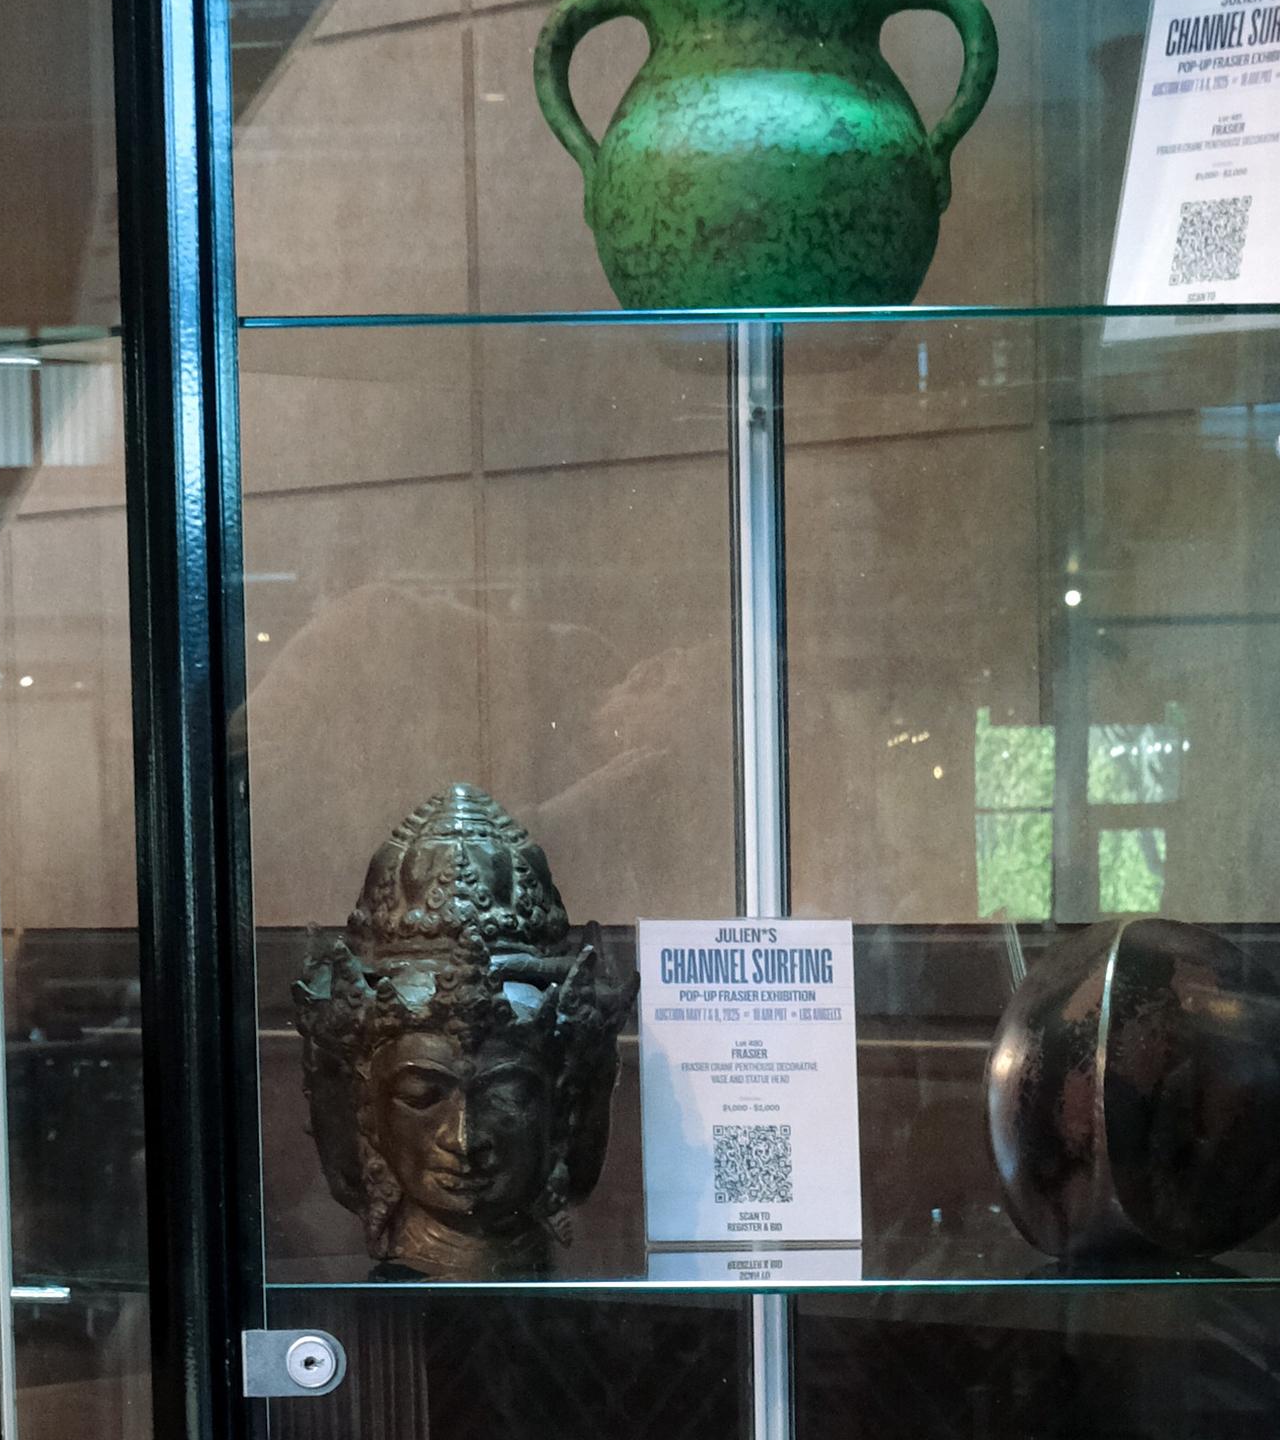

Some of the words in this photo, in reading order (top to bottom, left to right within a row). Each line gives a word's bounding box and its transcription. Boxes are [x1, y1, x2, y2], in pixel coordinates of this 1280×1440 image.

[1165, 10, 1247, 56] CHANNEL
[1178, 58, 1212, 74] POP-UP
[1212, 54, 1250, 70] FRASIER
[1211, 122, 1245, 136] FRASIER
[660, 948, 749, 984] CHANNEL
[751, 948, 833, 984] SURFING
[679, 990, 718, 1002] POP-UP
[719, 990, 759, 1002] FRASIER
[761, 990, 816, 1002] EXHIBITION
[731, 1049, 768, 1059] FRASIER
[681, 1062, 709, 1072] FRASIER
[710, 1062, 733, 1072] CRANE
[735, 1062, 775, 1072] PENTHOUSE
[776, 1062, 817, 1072] DECORATIVE
[729, 1075, 745, 1084] AND
[746, 1075, 770, 1084] STATUE
[739, 1212, 759, 1220] SCAN
[760, 1212, 770, 1220] TO
[727, 1223, 762, 1231] REGISTER
[770, 1223, 783, 1231] BID
